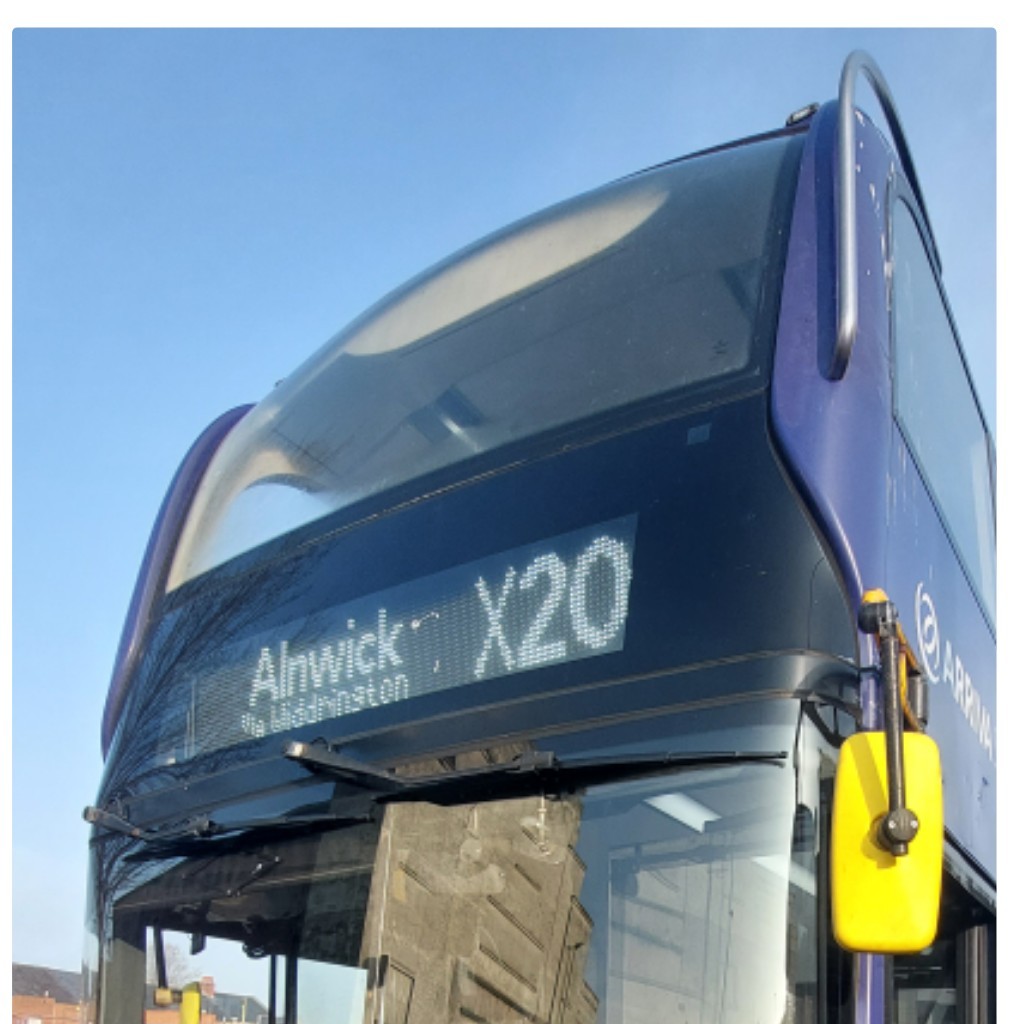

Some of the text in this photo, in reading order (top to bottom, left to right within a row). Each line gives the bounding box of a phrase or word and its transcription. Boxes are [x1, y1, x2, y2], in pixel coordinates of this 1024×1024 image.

[249, 608, 403, 706] Alnwick
[475, 535, 632, 678] X20
[943, 640, 993, 761] ARRIVA
